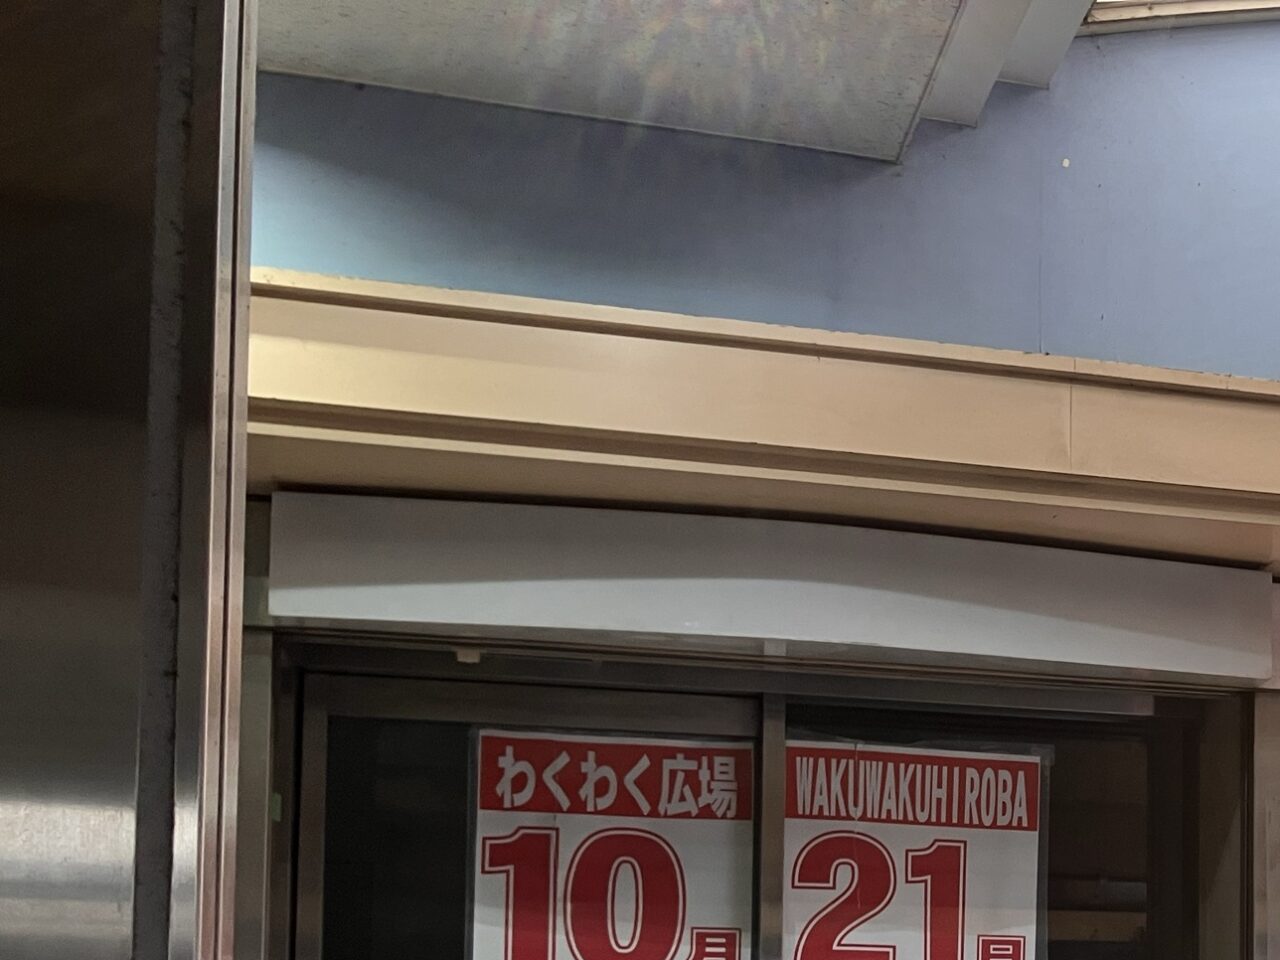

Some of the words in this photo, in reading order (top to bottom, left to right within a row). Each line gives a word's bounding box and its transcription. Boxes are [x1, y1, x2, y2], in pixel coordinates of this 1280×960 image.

[495, 745, 738, 818] わくわく広場
[796, 757, 1028, 827] WAKUWAKUHIROBA
